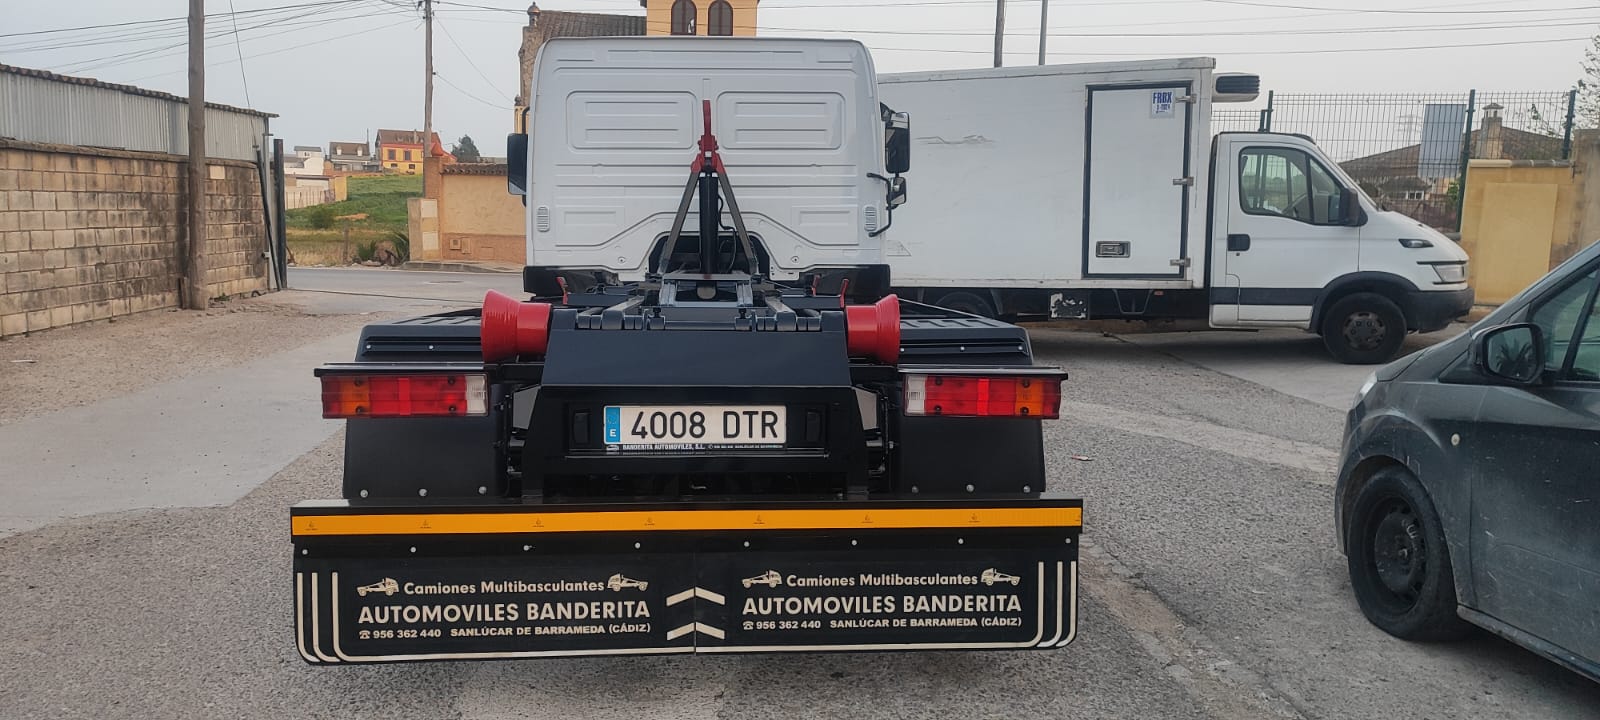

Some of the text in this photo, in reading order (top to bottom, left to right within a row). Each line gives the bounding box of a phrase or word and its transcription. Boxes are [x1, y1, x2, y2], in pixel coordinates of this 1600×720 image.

[609, 411, 778, 439] E 4008 DTR
[404, 579, 604, 594] Camiones Multibasculantes
[787, 573, 978, 586] Camiones Multibasculantes
[358, 600, 650, 624] AUTOMOVILES BANDERITA
[742, 595, 1022, 615] AUTOMOVILES BANDERITA
[373, 622, 650, 639] 956 362 440 SANLÚCAR DE BARRAMEDA (CÁDIZ)
[756, 616, 1022, 630] 956 362 440 SANLÚCAR DE BARRAMEDA (CÁDIZ)
